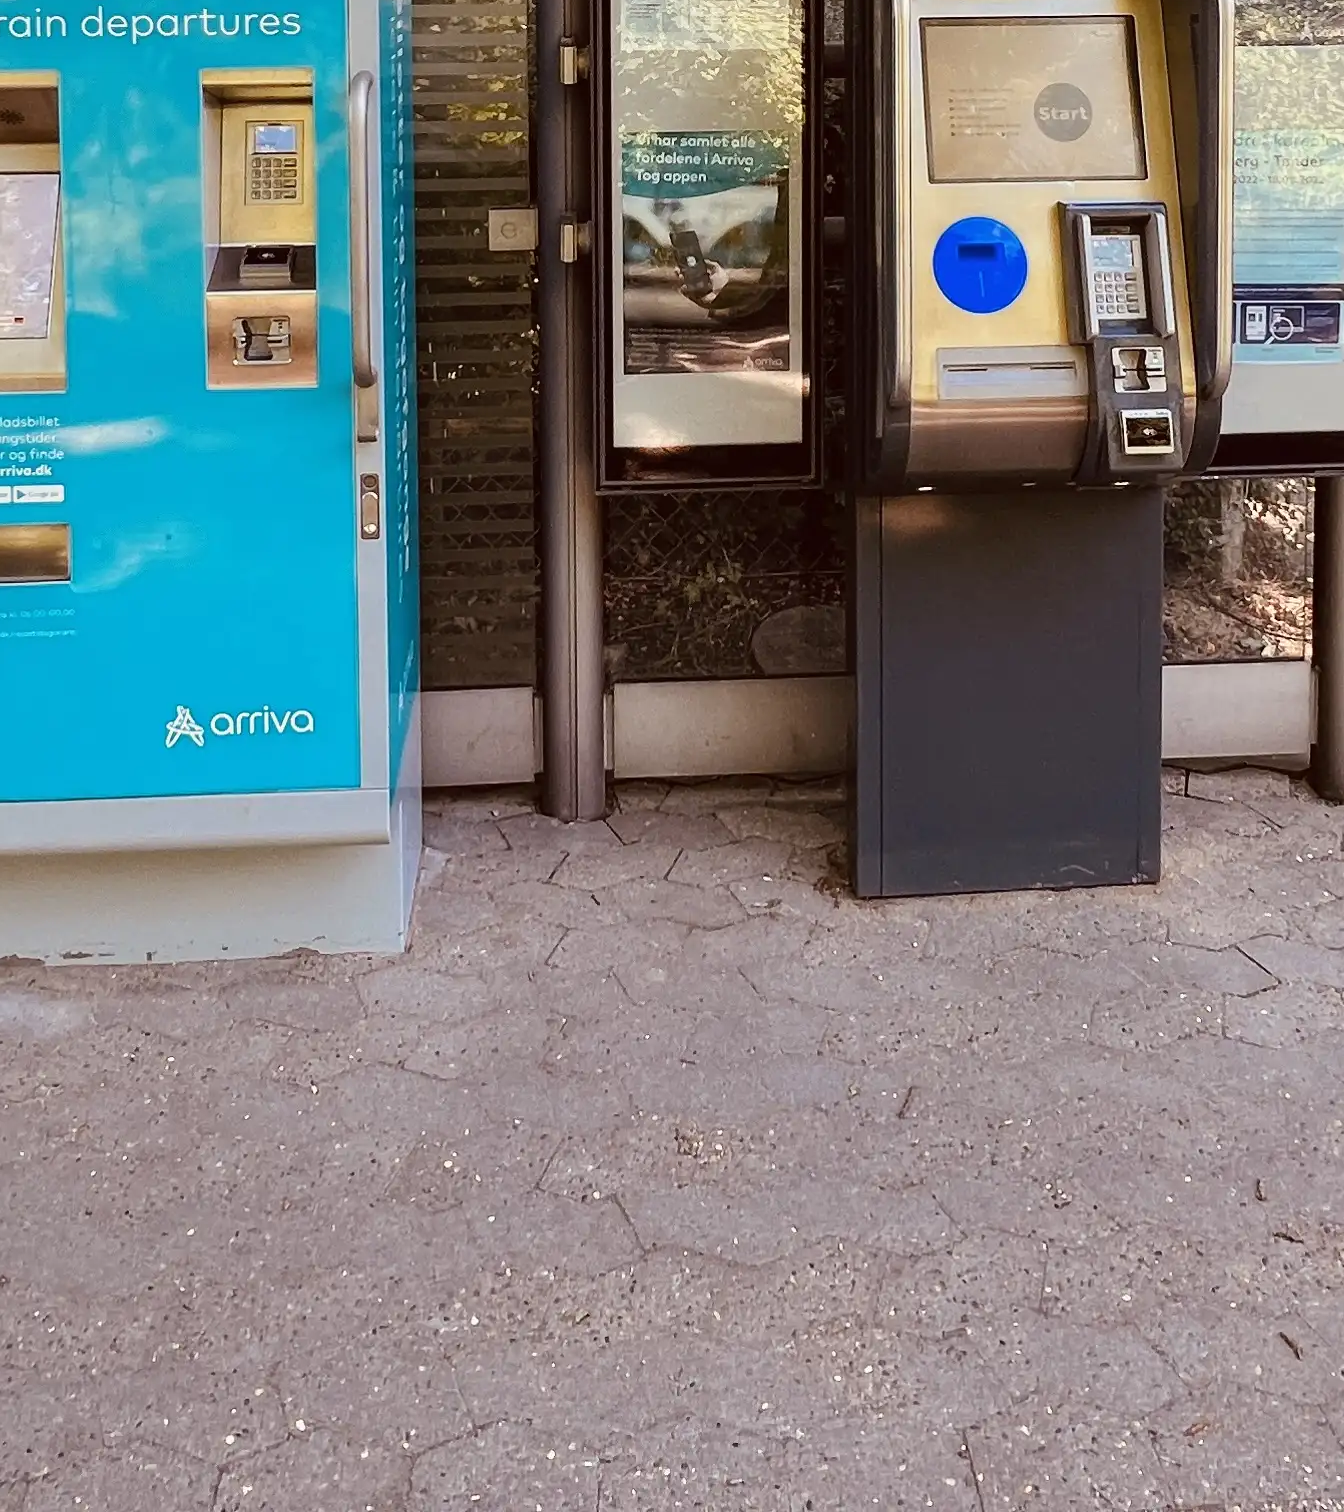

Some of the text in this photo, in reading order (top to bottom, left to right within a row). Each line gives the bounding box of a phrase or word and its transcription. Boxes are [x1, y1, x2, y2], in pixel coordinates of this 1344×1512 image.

[80, 5, 302, 45] departures
[1039, 106, 1088, 121] Start
[680, 136, 729, 148] samlet
[731, 135, 756, 148] alle
[636, 151, 754, 166] fordelene i Arriva
[635, 168, 707, 185] Tog appen
[8, 452, 27, 463] og
[29, 448, 65, 461] finde
[210, 705, 315, 736] arriva
